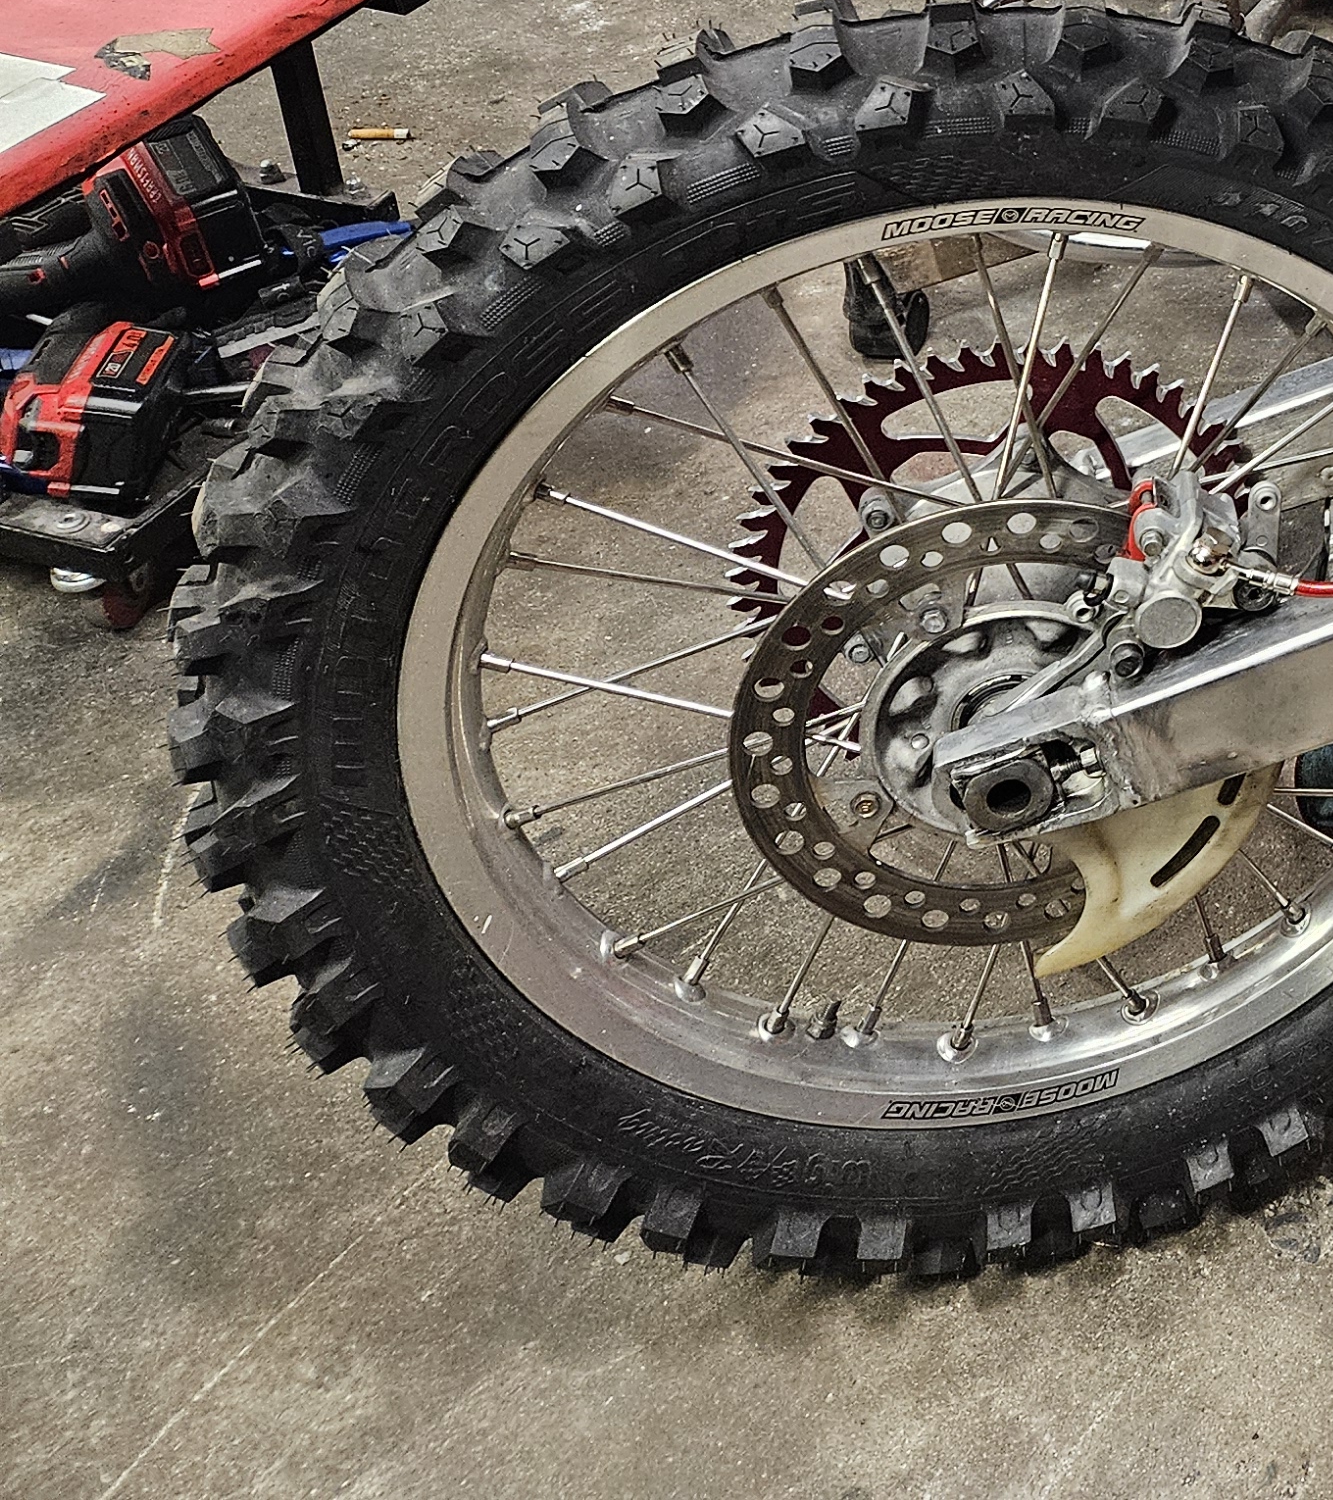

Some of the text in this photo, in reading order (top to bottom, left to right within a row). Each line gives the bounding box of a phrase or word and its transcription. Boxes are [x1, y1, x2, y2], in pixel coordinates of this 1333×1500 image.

[881, 207, 1146, 241] MOOSE RACING
[881, 1068, 1119, 1119] MOOSE RACING
